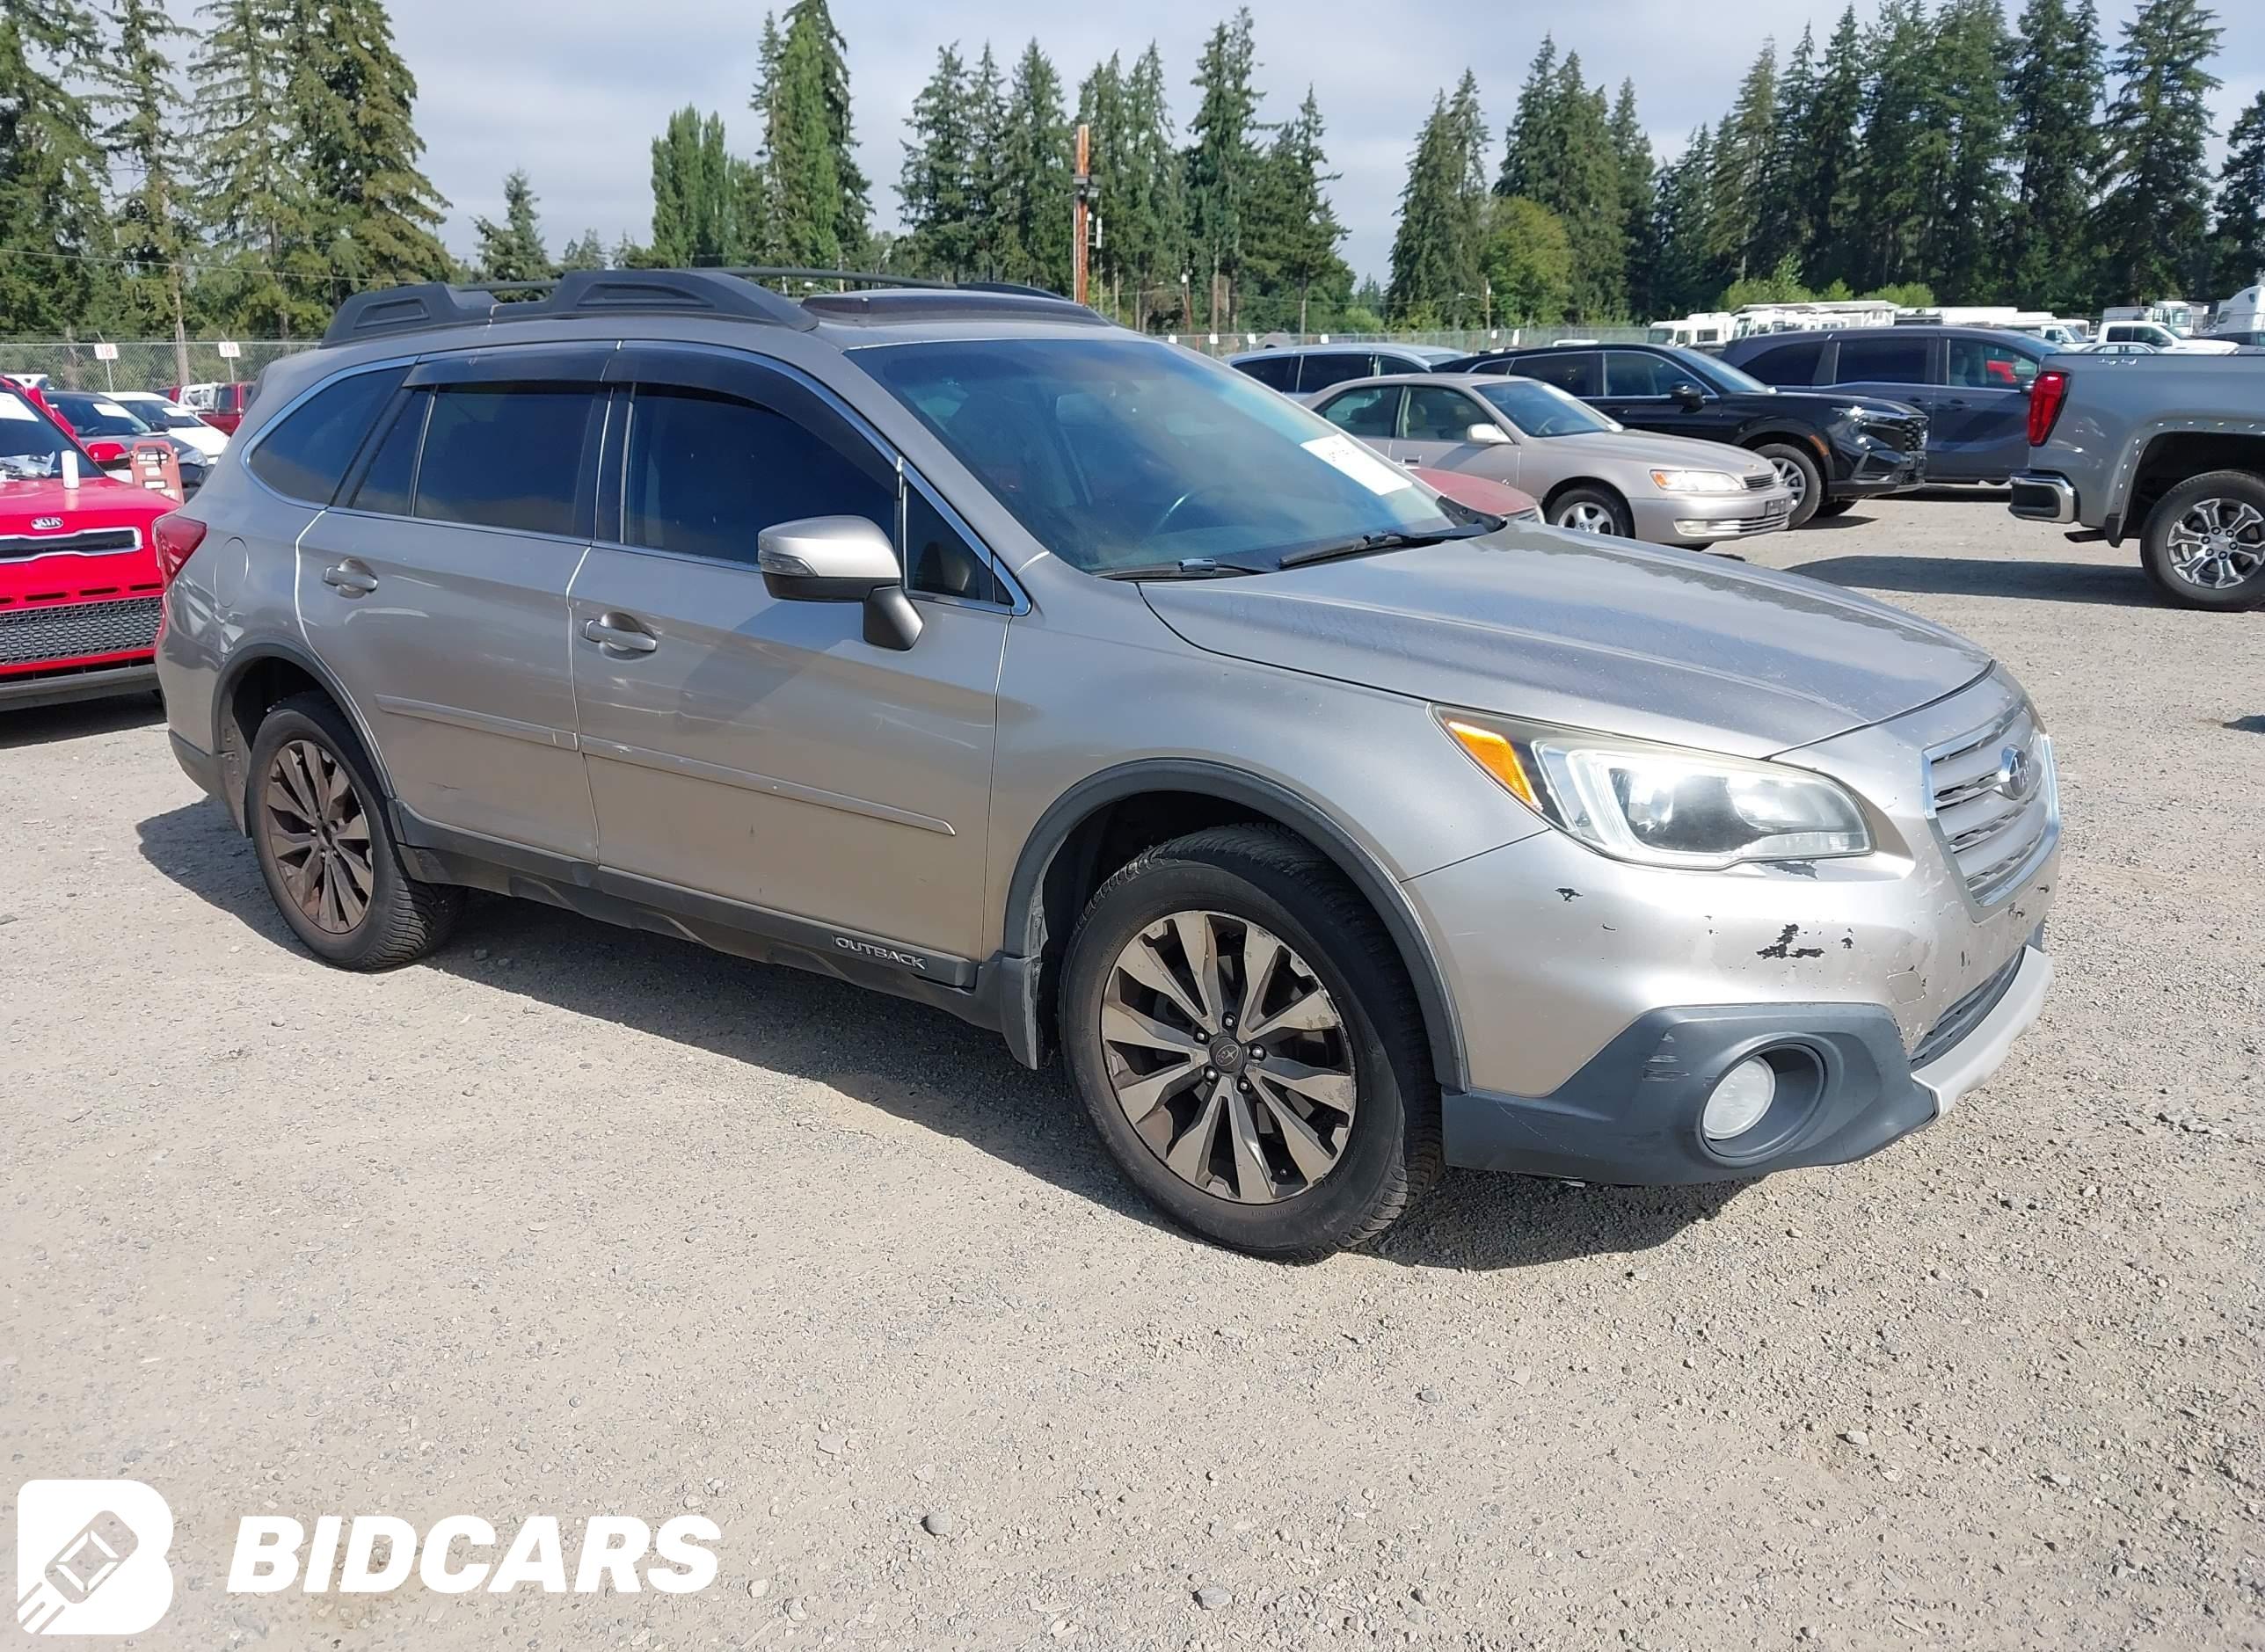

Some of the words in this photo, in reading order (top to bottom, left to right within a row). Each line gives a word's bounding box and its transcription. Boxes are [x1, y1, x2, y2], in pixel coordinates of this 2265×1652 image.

[99, 346, 113, 358] 18
[223, 344, 236, 356] 19
[33, 518, 62, 528] KIA
[835, 937, 925, 970] OUTBACK
